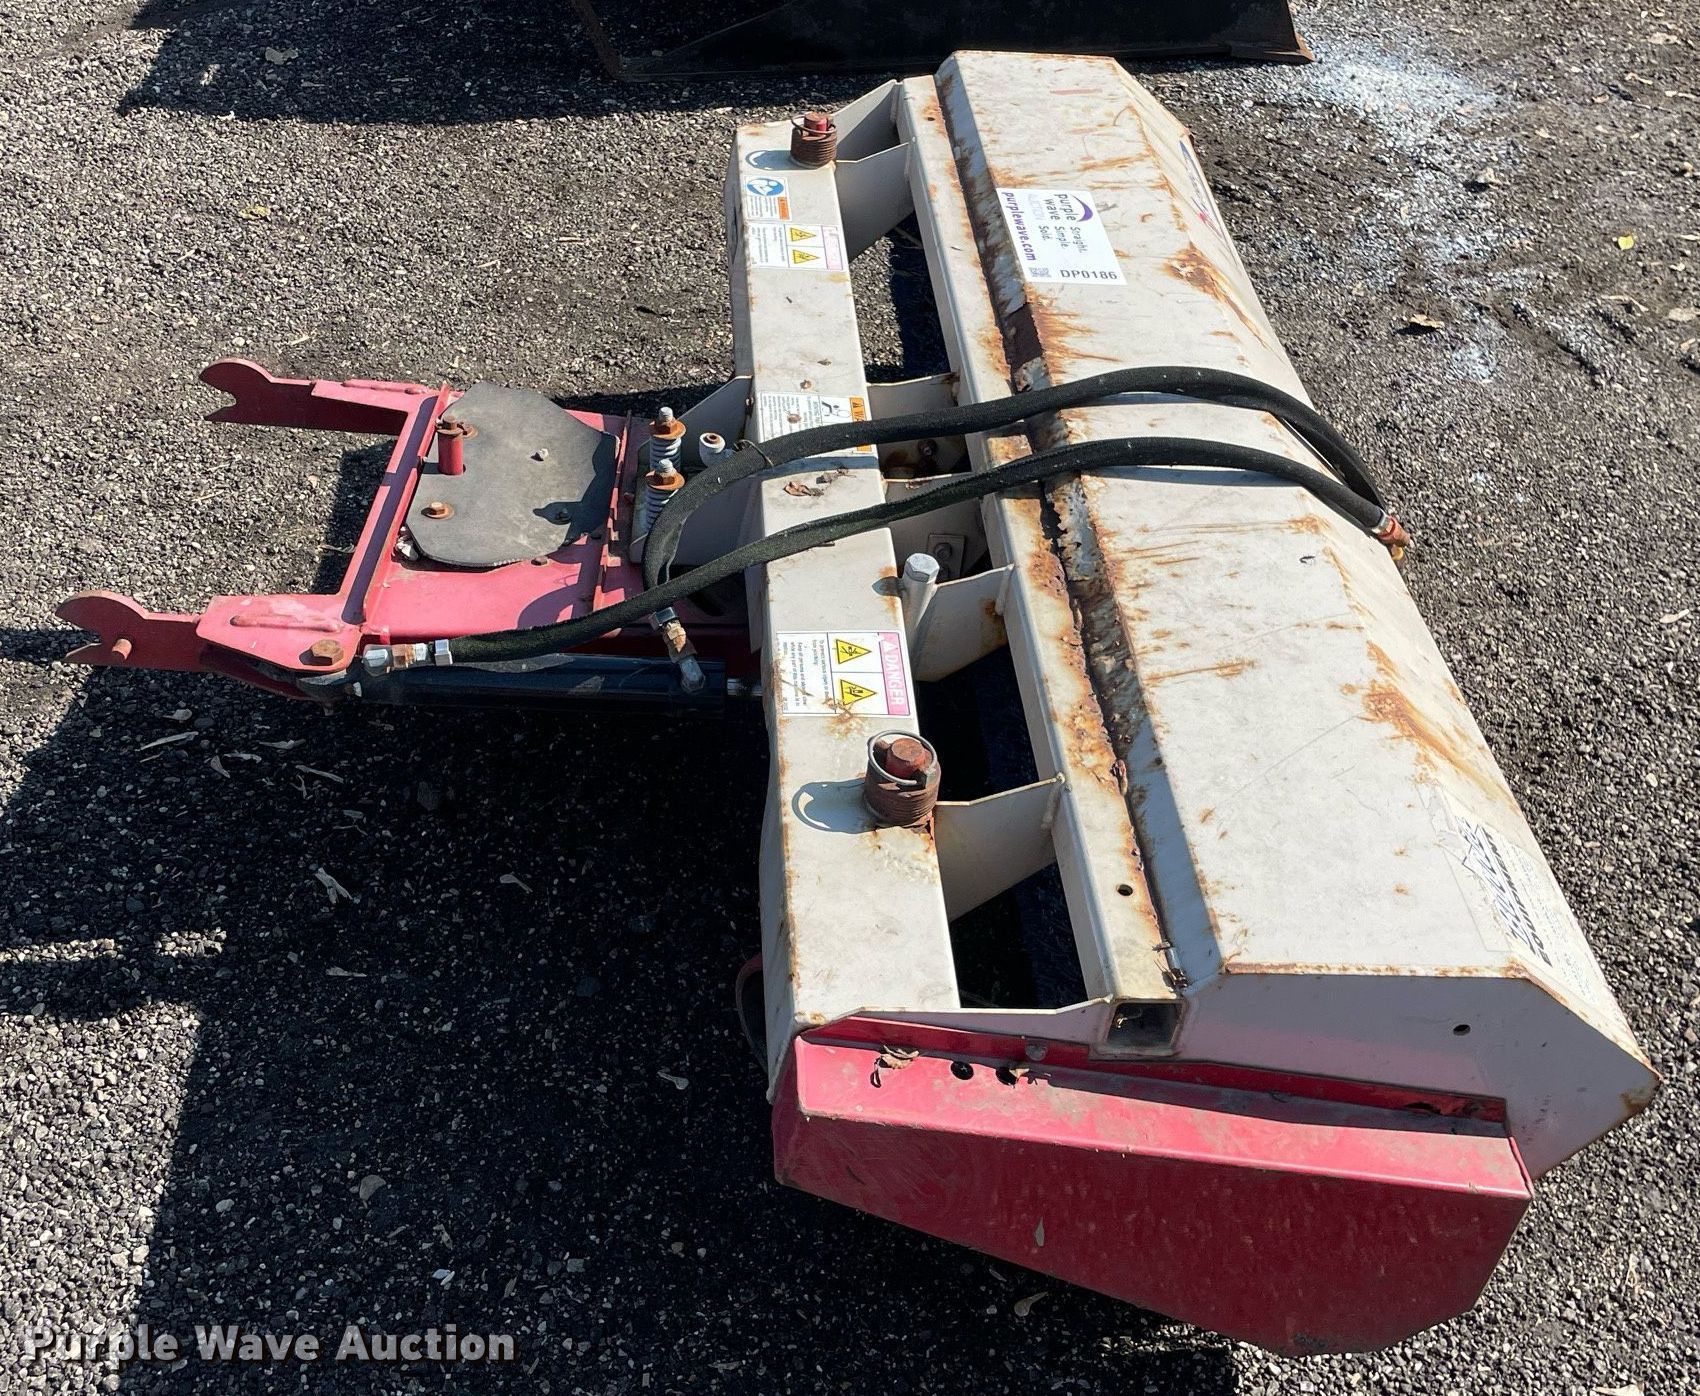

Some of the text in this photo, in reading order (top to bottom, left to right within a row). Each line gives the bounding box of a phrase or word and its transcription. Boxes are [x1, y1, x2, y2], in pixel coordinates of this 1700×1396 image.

[1001, 191, 1036, 261] purplewave.com
[1043, 198, 1060, 221] wave
[1054, 193, 1080, 221] purple
[1060, 269, 1118, 280] DP0186
[885, 655, 904, 705] DANGER
[1481, 827, 1553, 968] EQUIPMENT
